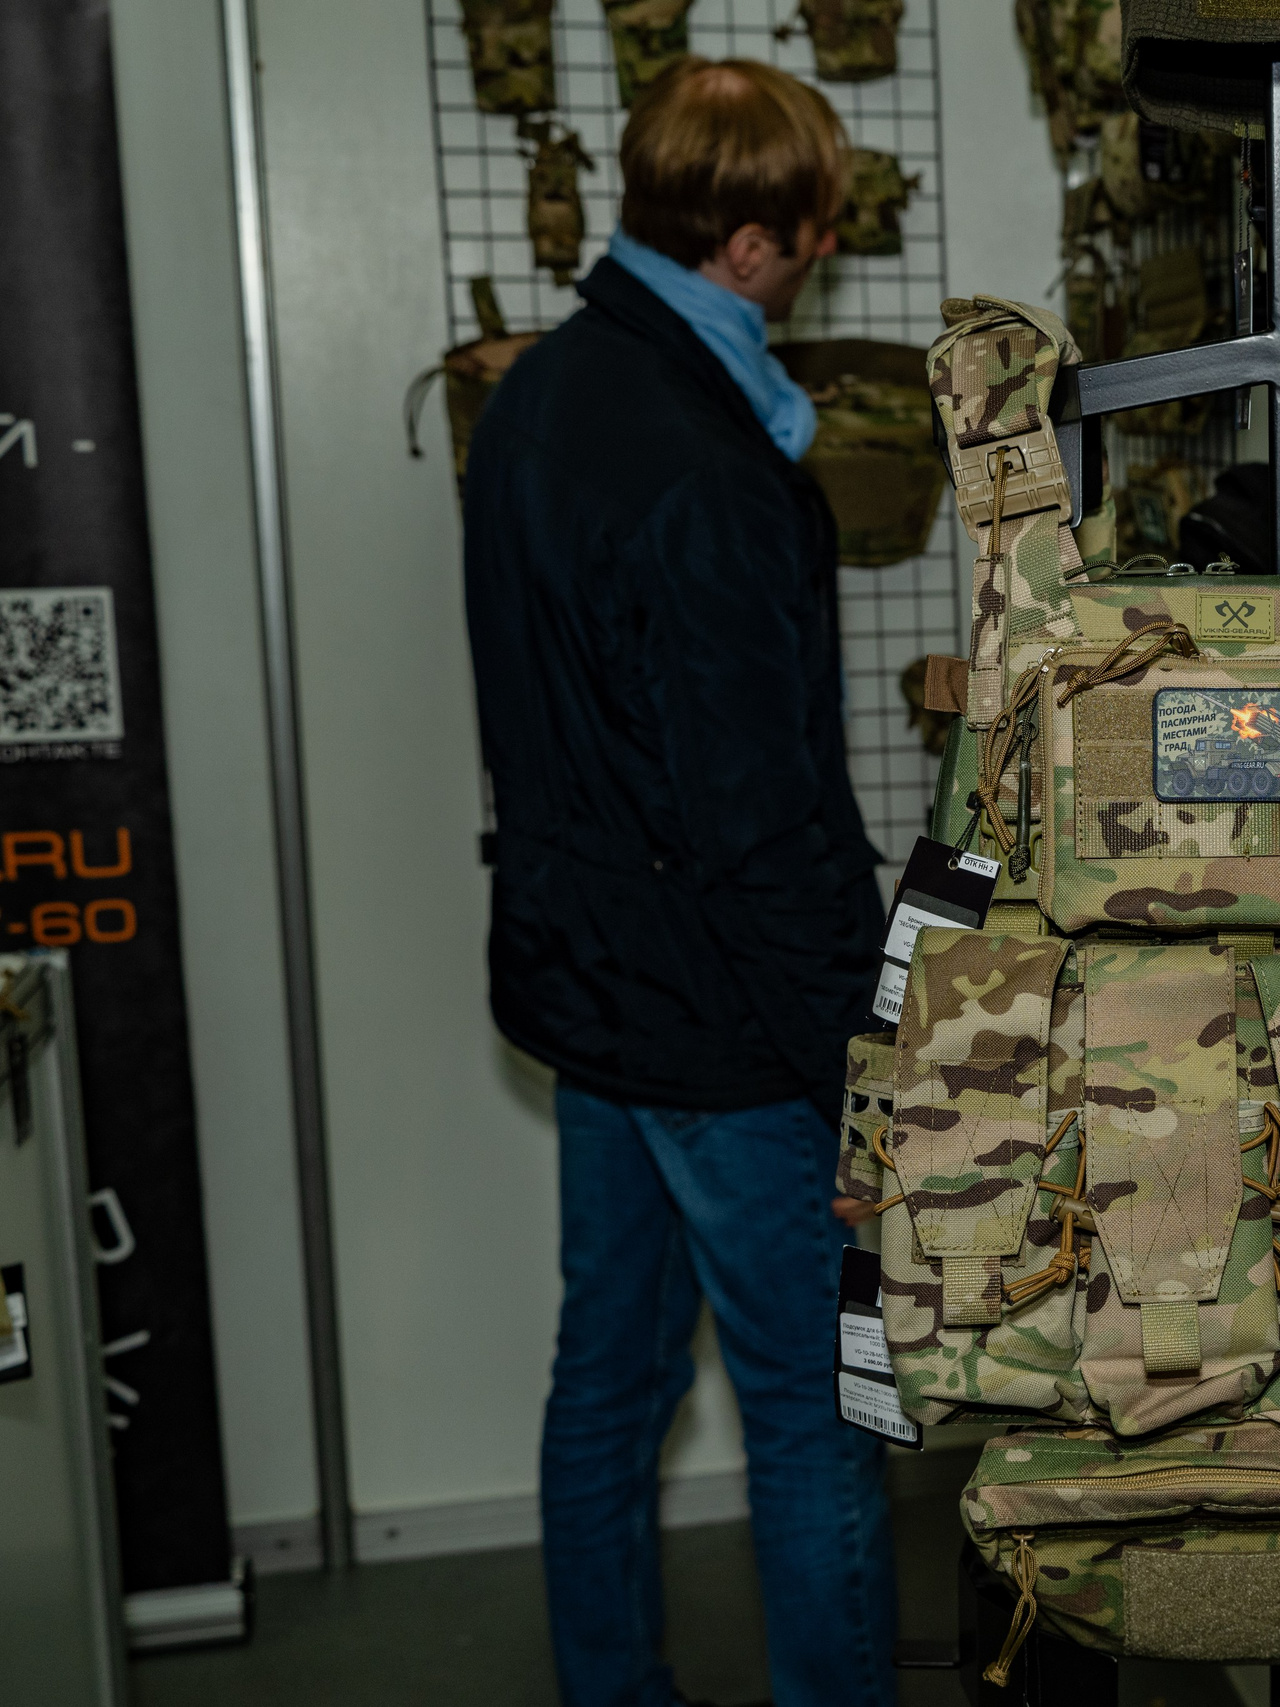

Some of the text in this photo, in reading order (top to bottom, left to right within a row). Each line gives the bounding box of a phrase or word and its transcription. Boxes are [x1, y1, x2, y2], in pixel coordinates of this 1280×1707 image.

[1159, 704, 1196, 717] ПОГОДА
[1161, 713, 1216, 728] ПАСМУРНАЯ
[1163, 727, 1207, 740] МЕСТАМИ
[1164, 742, 1187, 752] ГРАД
[964, 858, 978, 867] ОТК
[978, 863, 988, 871] НН
[0, 898, 137, 946] -60
